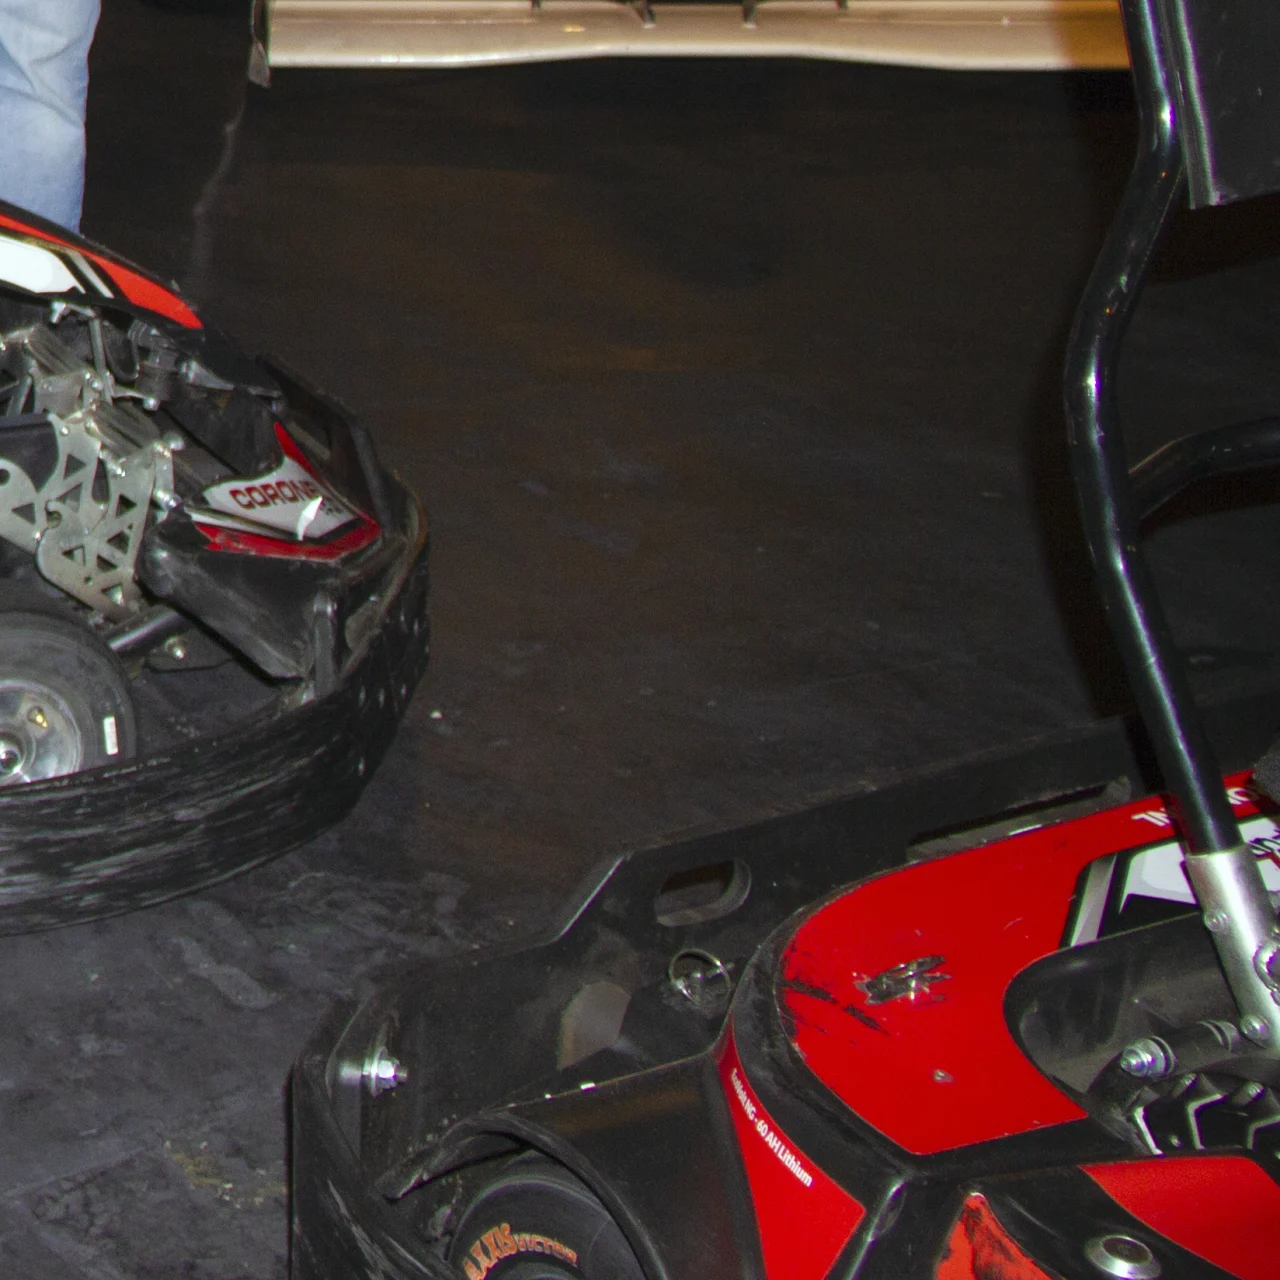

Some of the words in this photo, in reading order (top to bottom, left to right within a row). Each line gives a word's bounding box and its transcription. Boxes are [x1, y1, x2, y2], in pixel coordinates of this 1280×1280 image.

[756, 1119, 769, 1138] 60
[764, 1131, 782, 1153] AH
[777, 1145, 813, 1188] Lithium
